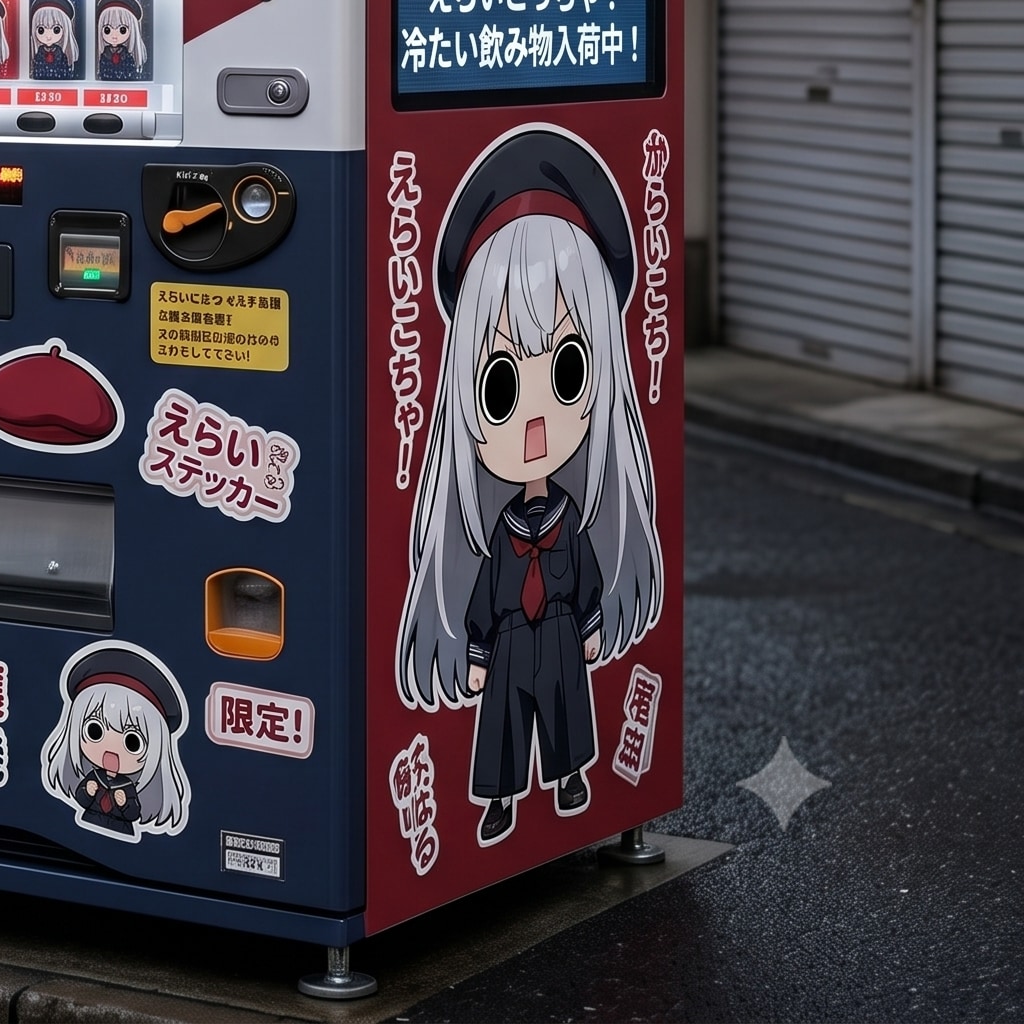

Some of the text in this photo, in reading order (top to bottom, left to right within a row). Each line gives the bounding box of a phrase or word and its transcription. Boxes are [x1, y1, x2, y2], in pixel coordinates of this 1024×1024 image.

[401, 22, 638, 72] 冷たい飲み物入荷中！
[159, 401, 260, 467] えらい
[150, 446, 279, 509] ステッカー
[221, 695, 303, 744] 限定!
